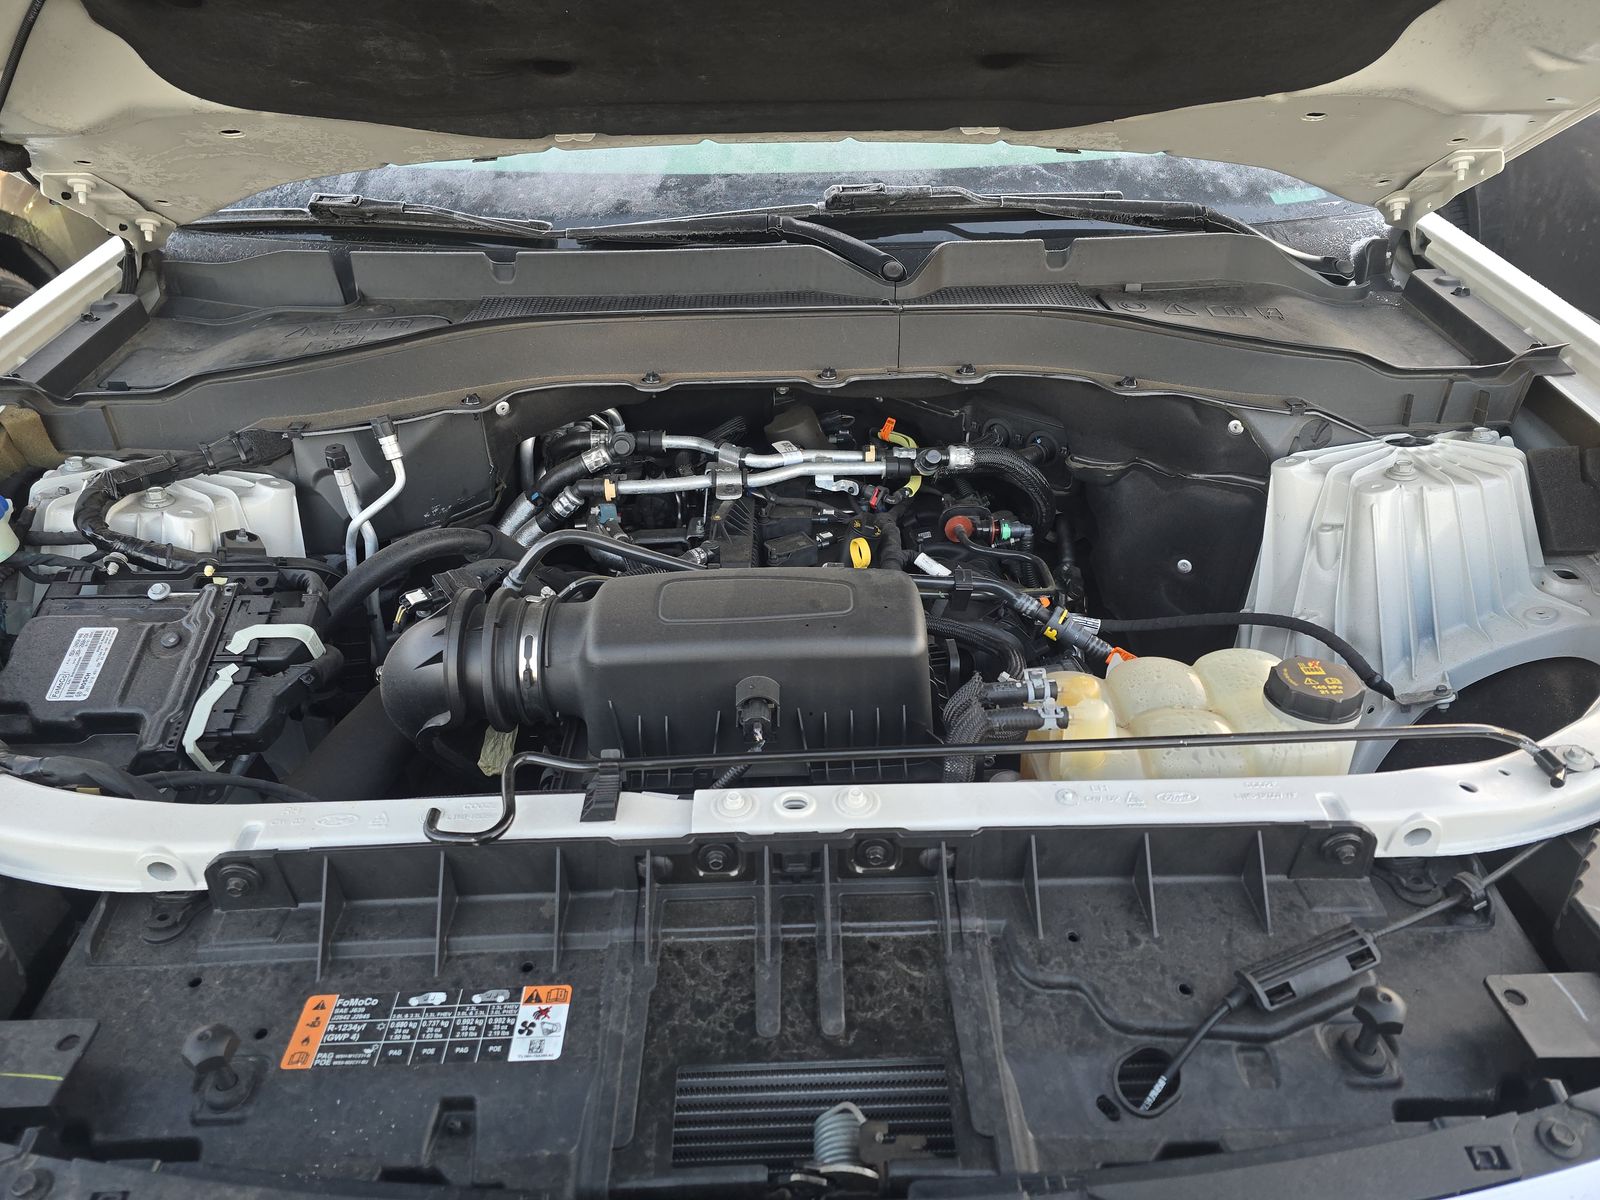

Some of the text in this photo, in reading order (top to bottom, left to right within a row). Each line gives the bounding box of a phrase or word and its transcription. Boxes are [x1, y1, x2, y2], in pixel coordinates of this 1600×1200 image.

[79, 672, 91, 690] BOSCH
[52, 675, 67, 698] FoMoCo
[336, 997, 379, 1007] FoMoCo
[408, 1021, 418, 1029] kg
[475, 1018, 484, 1026] kg
[506, 1017, 516, 1025] kg
[326, 1023, 367, 1032] R-1234yf
[323, 1032, 361, 1043] (GWP 4)
[421, 1047, 436, 1055] POE
[454, 1046, 469, 1054] PAG
[488, 1045, 502, 1053] POE
